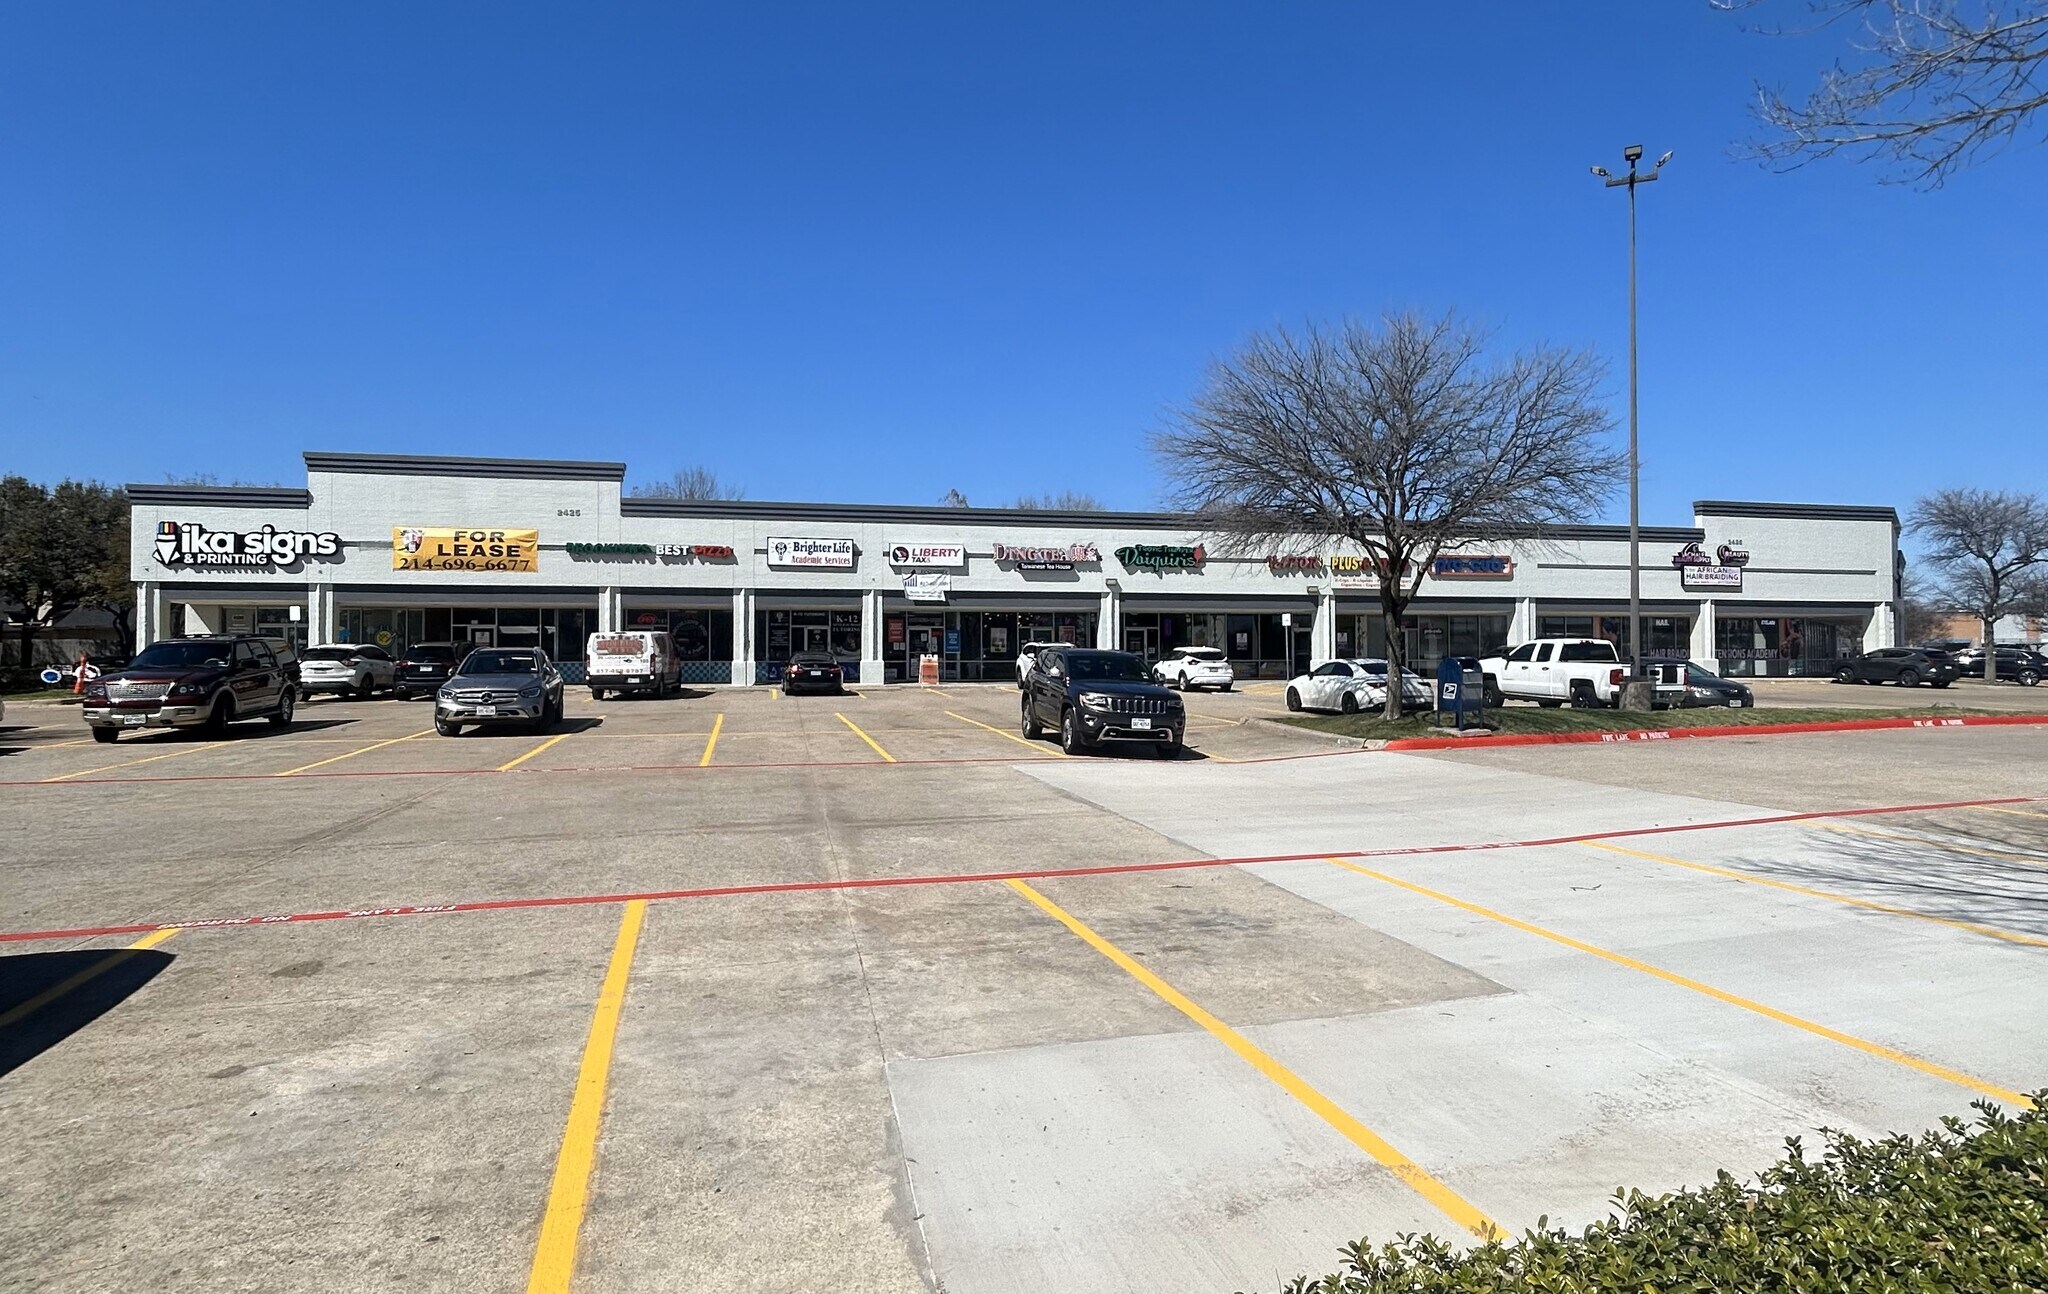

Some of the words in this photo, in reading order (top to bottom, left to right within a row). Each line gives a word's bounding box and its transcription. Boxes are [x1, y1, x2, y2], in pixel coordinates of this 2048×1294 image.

[454, 530, 506, 544] FOR
[181, 525, 237, 554] ika
[244, 525, 337, 566] signs
[437, 543, 521, 558] LEASE
[655, 544, 690, 556] BEST
[693, 545, 734, 557] PIZZA
[792, 541, 832, 556] Brighter
[833, 542, 851, 554] Life
[183, 553, 194, 565] &
[196, 553, 268, 565] PRINTING
[912, 548, 961, 558] LIBERTY
[1114, 548, 1195, 571] Daiquiris
[400, 559, 530, 571] 214-696-6677
[791, 556, 823, 565] Academic
[824, 557, 851, 566] Services
[1331, 556, 1360, 571] PLUS
[837, 614, 859, 623] K-12
[1650, 648, 1666, 658] HAIR
[1715, 648, 1746, 659] TENSIONS
[1747, 648, 1778, 659] ACADEMY
